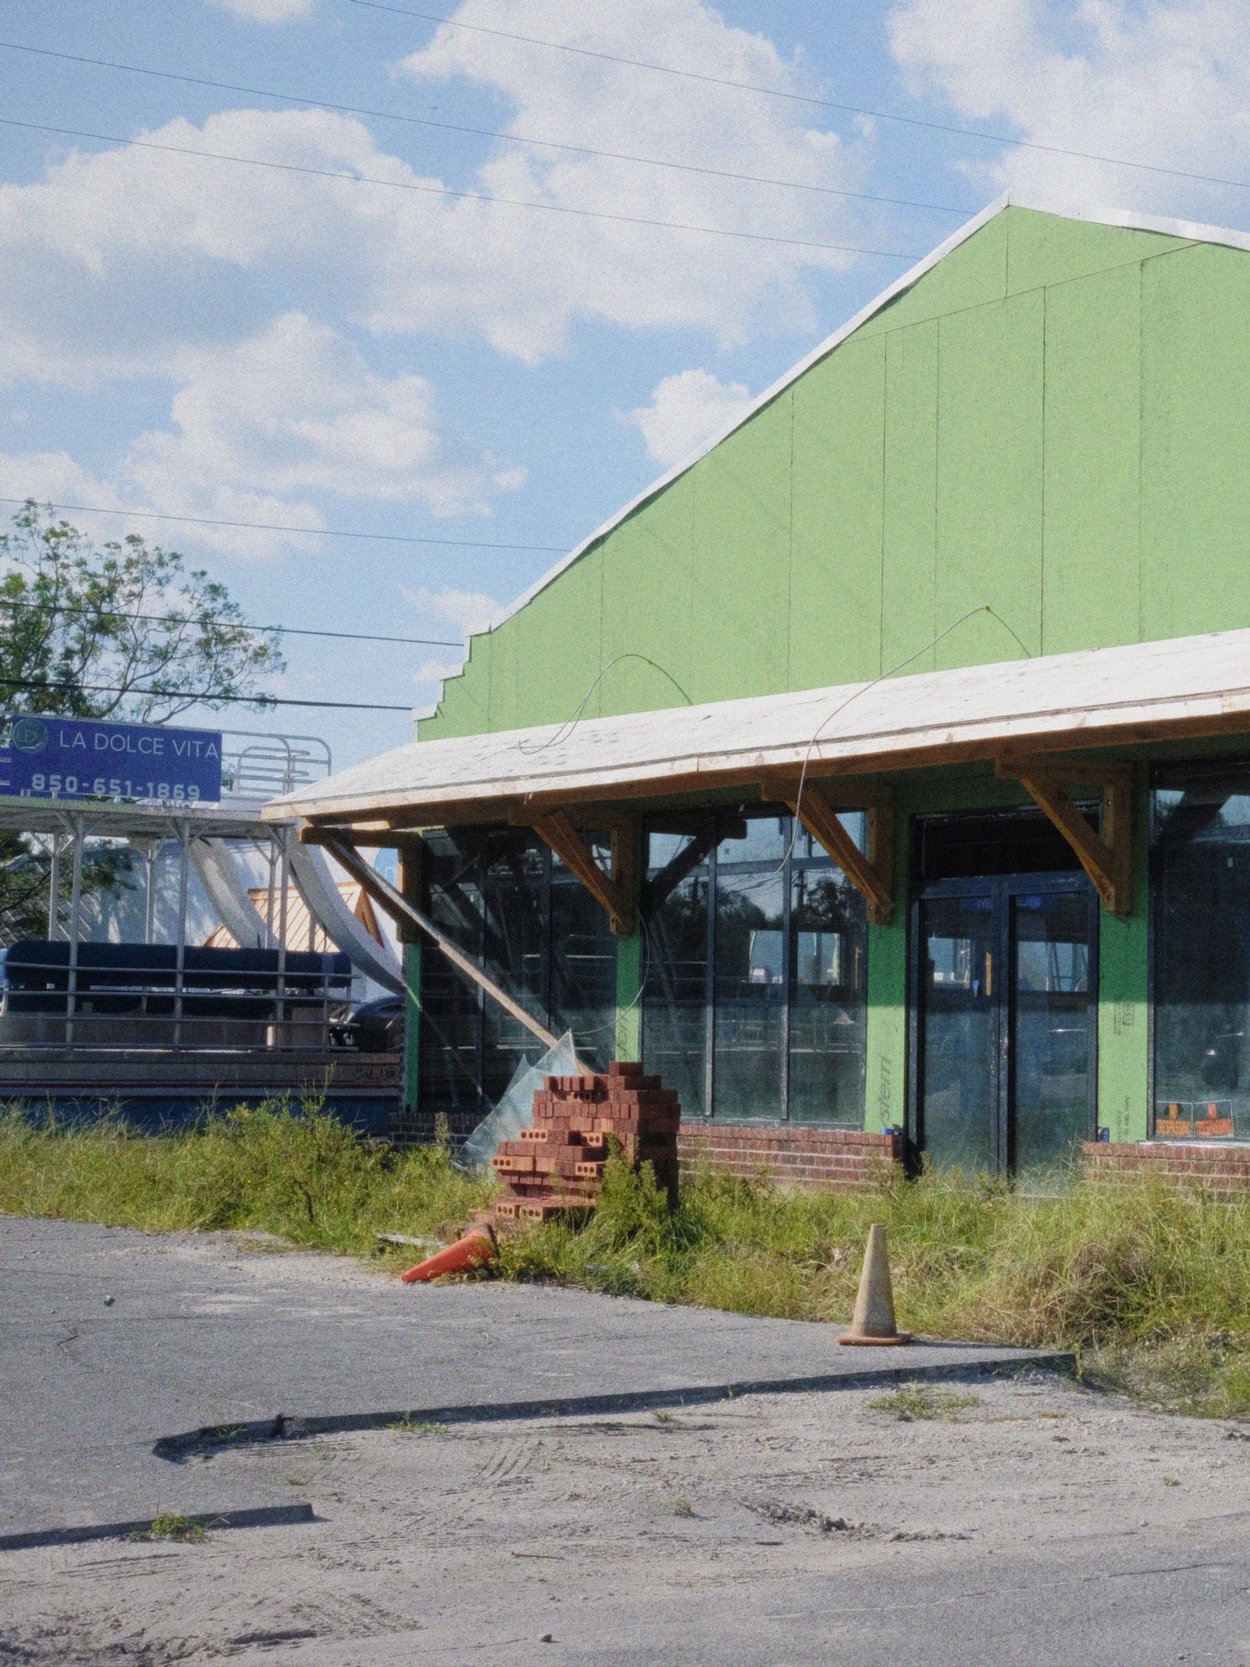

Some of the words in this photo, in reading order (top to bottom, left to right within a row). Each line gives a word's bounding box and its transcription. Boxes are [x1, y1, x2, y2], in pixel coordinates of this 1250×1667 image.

[59, 730, 87, 750] LA
[94, 733, 164, 756] DOLCE
[172, 740, 219, 759] VITA
[31, 773, 201, 800] 850-651-1869
